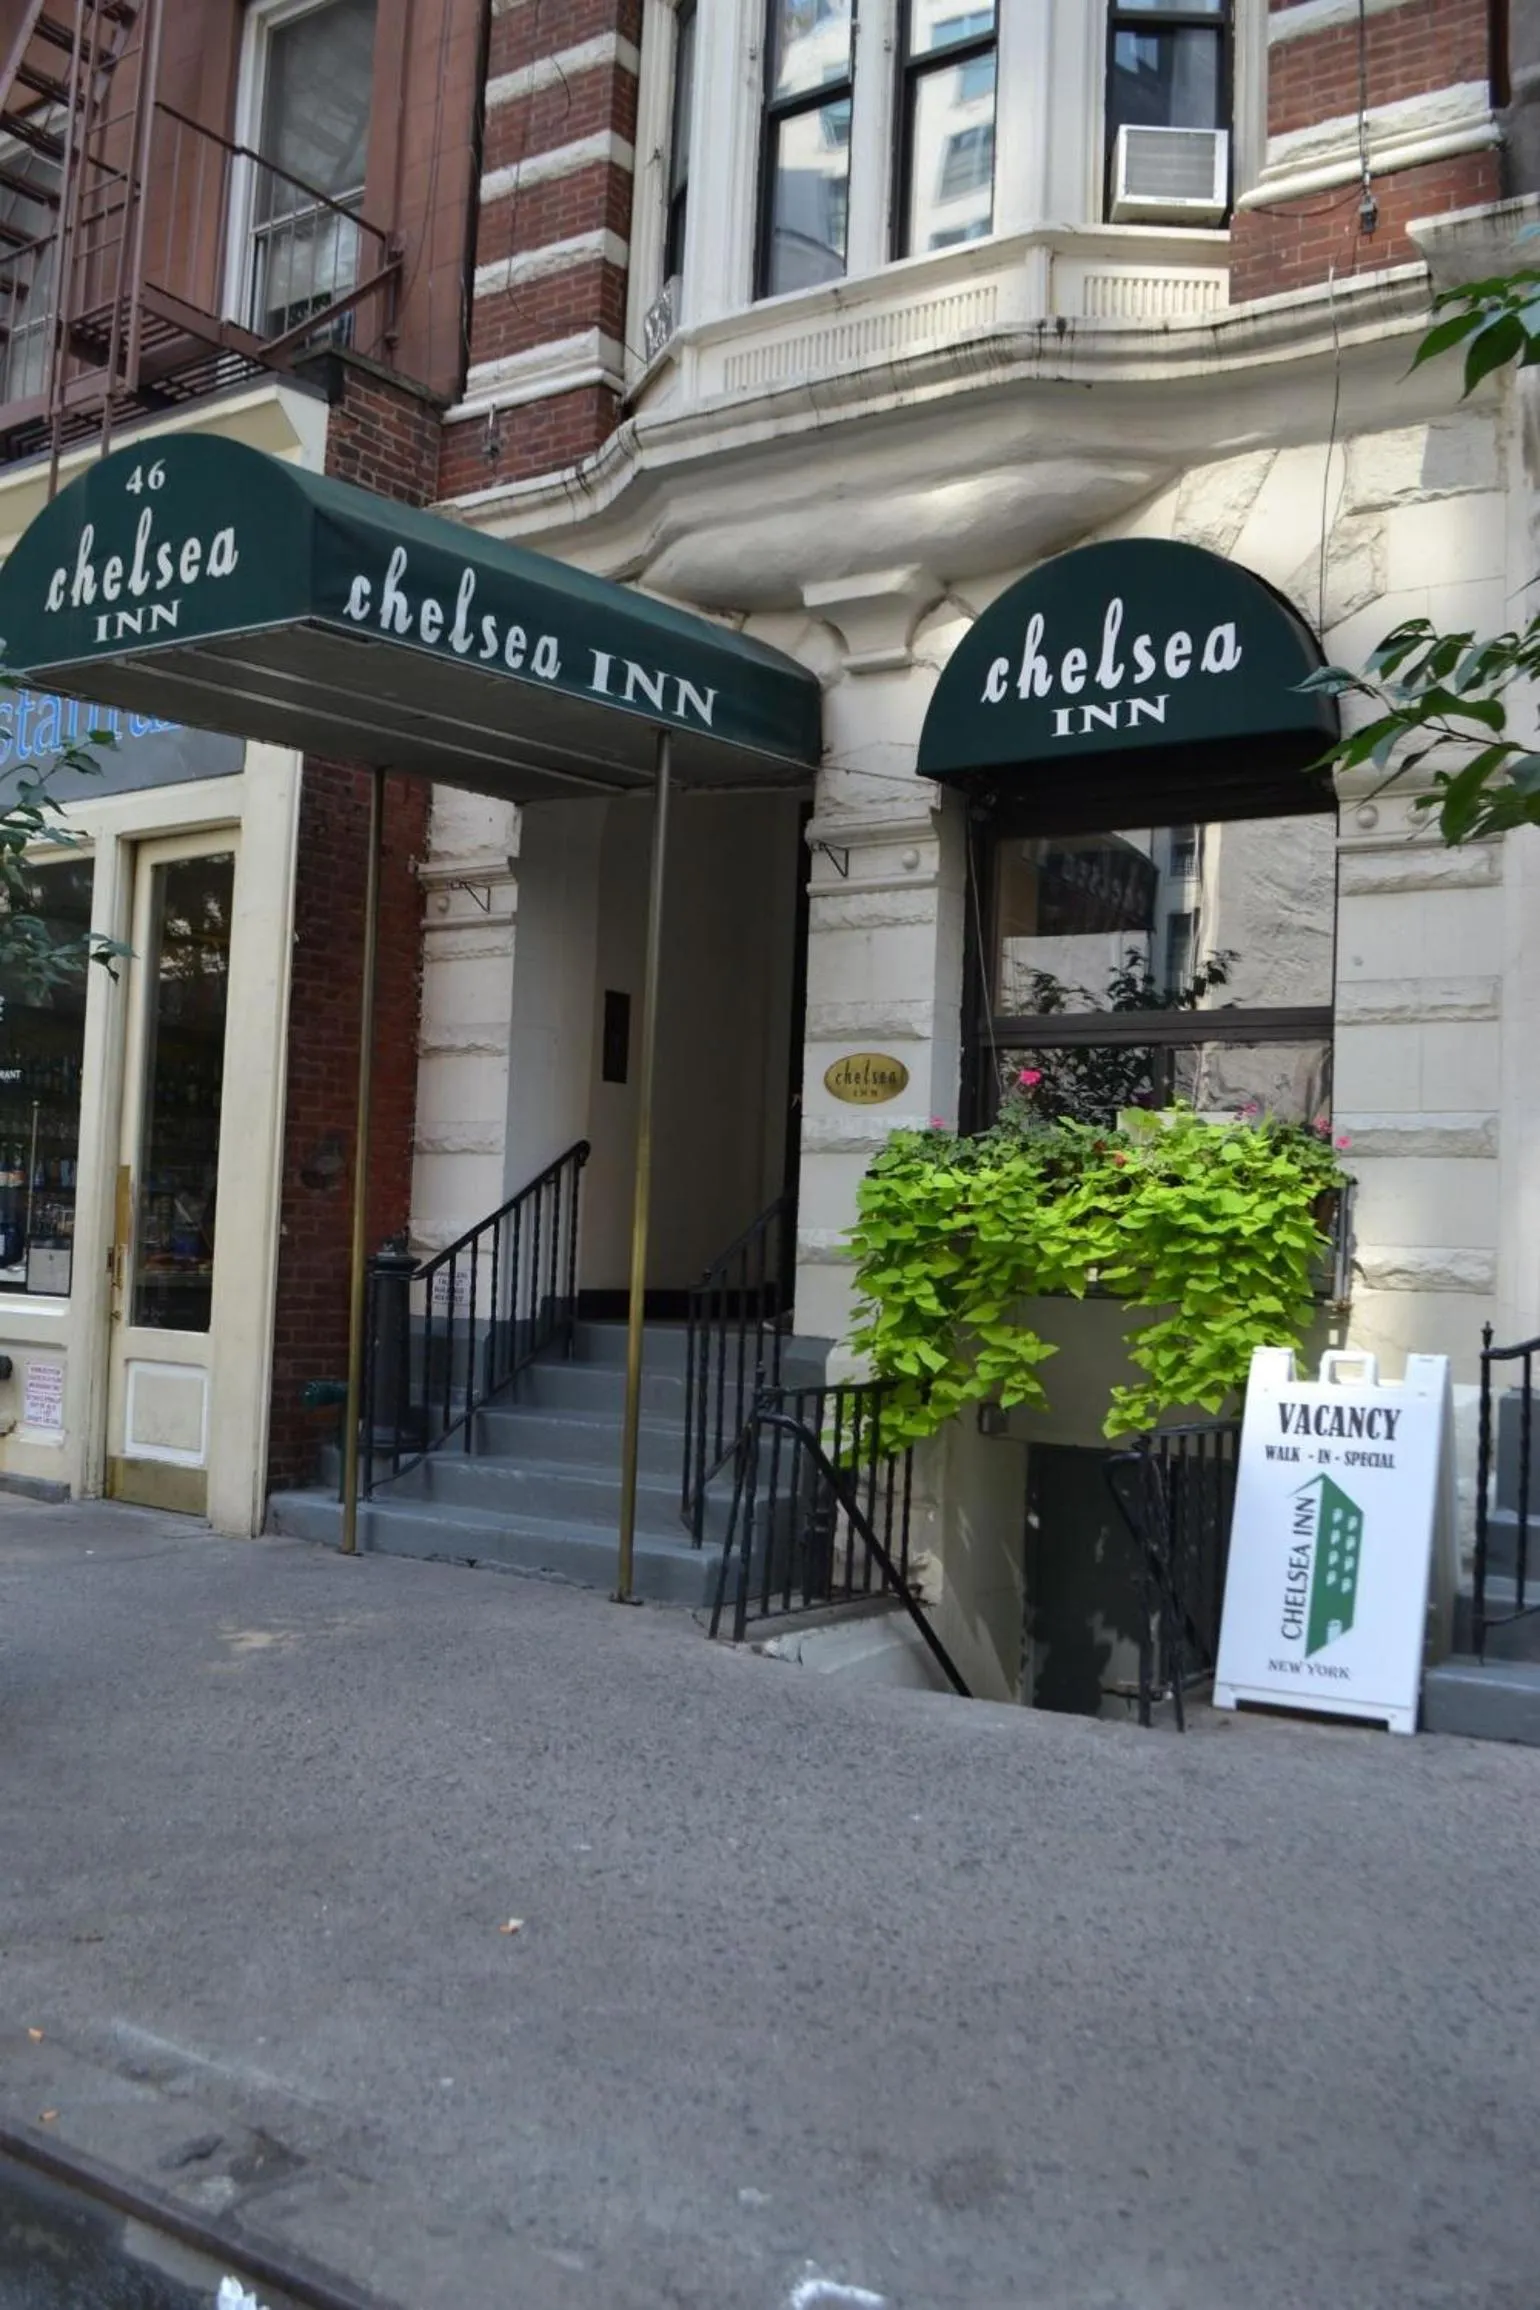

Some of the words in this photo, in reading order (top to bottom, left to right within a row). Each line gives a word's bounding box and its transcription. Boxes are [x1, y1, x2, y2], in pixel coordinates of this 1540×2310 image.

[125, 459, 166, 494] 46
[45, 507, 239, 612] chelsea
[93, 600, 182, 643] INN
[343, 546, 562, 680] chelsea
[585, 648, 720, 727] INN
[980, 597, 1242, 703] chelsea
[1051, 694, 1171, 737] INN
[835, 1058, 897, 1085] chelsea
[1278, 1402, 1402, 1441] VACANCY
[1265, 1444, 1301, 1462] WALK
[1344, 1450, 1396, 1469] SPECIAL
[1292, 1496, 1317, 1537] INN
[1281, 1544, 1311, 1641] CHELSEA
[1267, 1657, 1301, 1673] NEW
[1306, 1660, 1351, 1680] YORK
